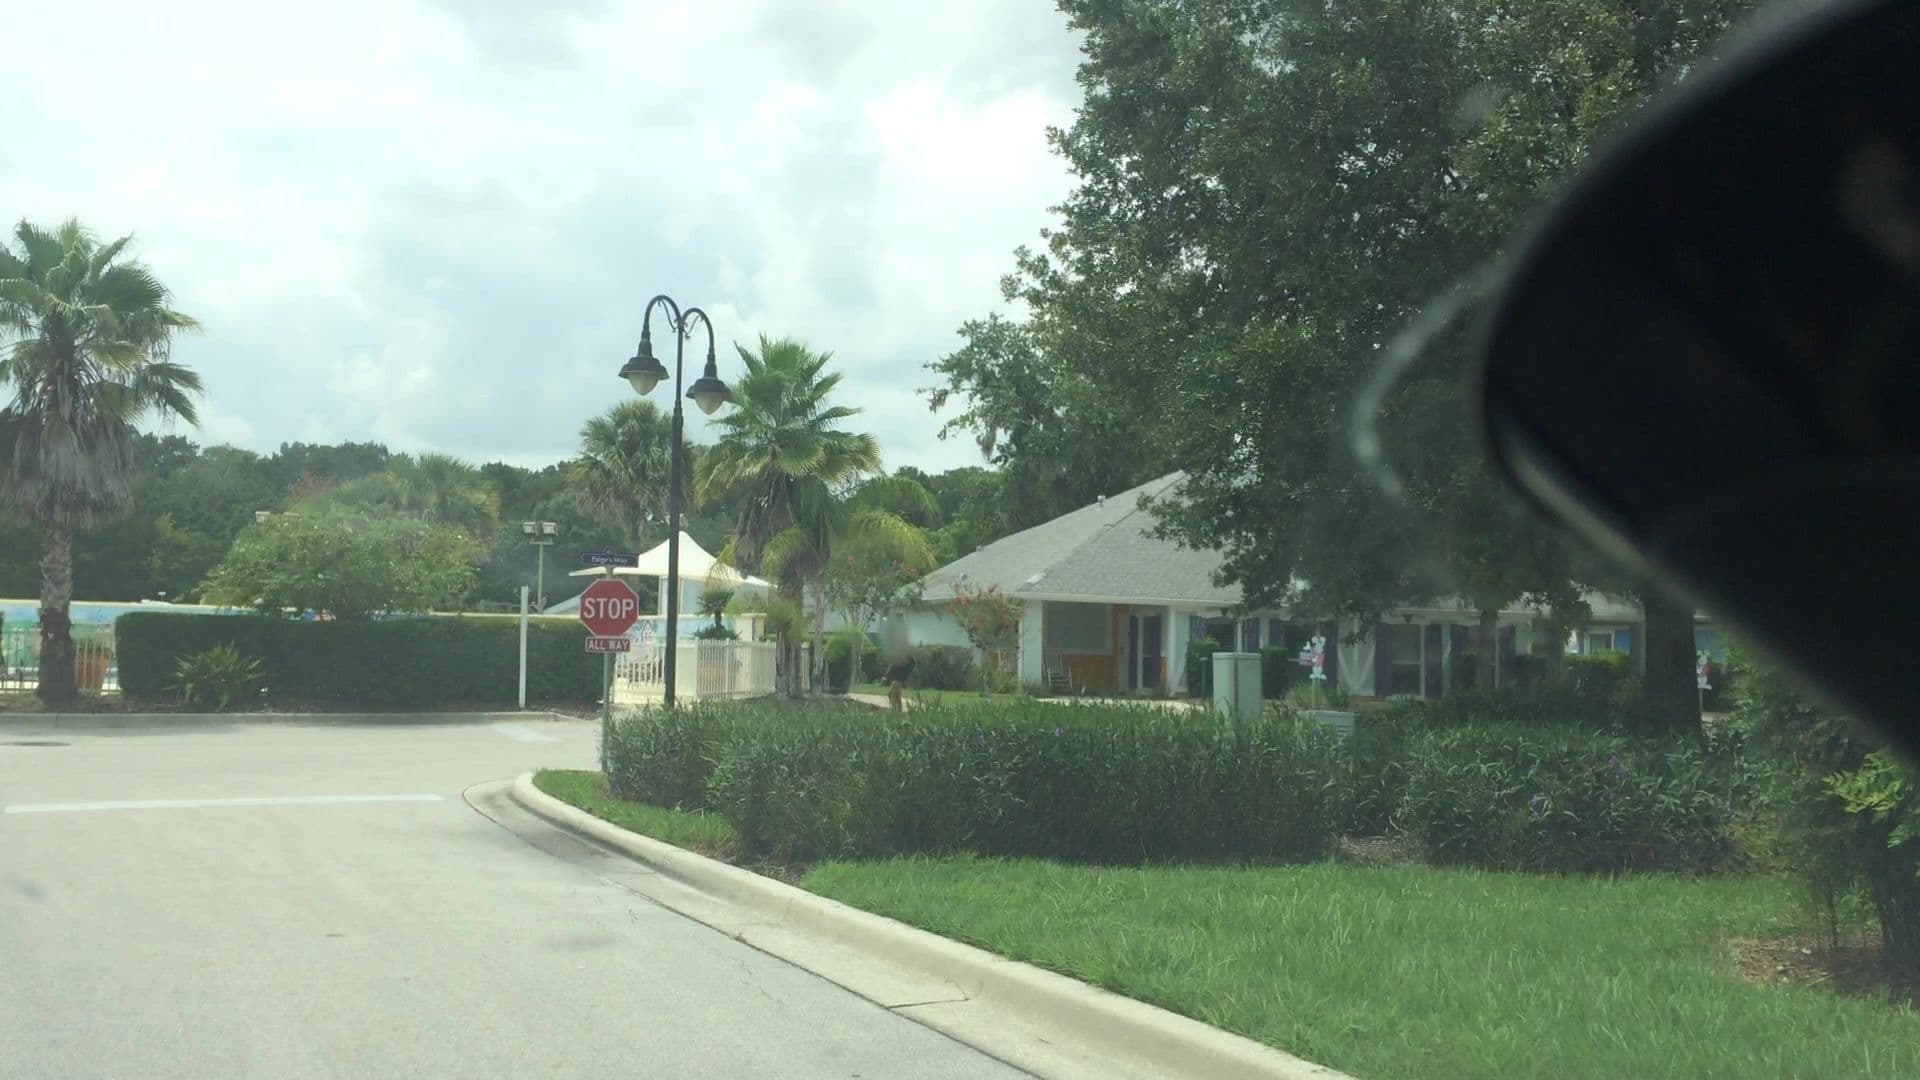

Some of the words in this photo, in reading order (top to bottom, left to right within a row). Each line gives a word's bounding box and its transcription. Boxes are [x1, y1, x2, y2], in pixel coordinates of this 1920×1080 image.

[583, 597, 635, 620] STOP
[588, 640, 607, 651] ALL
[608, 640, 629, 651] WAY
